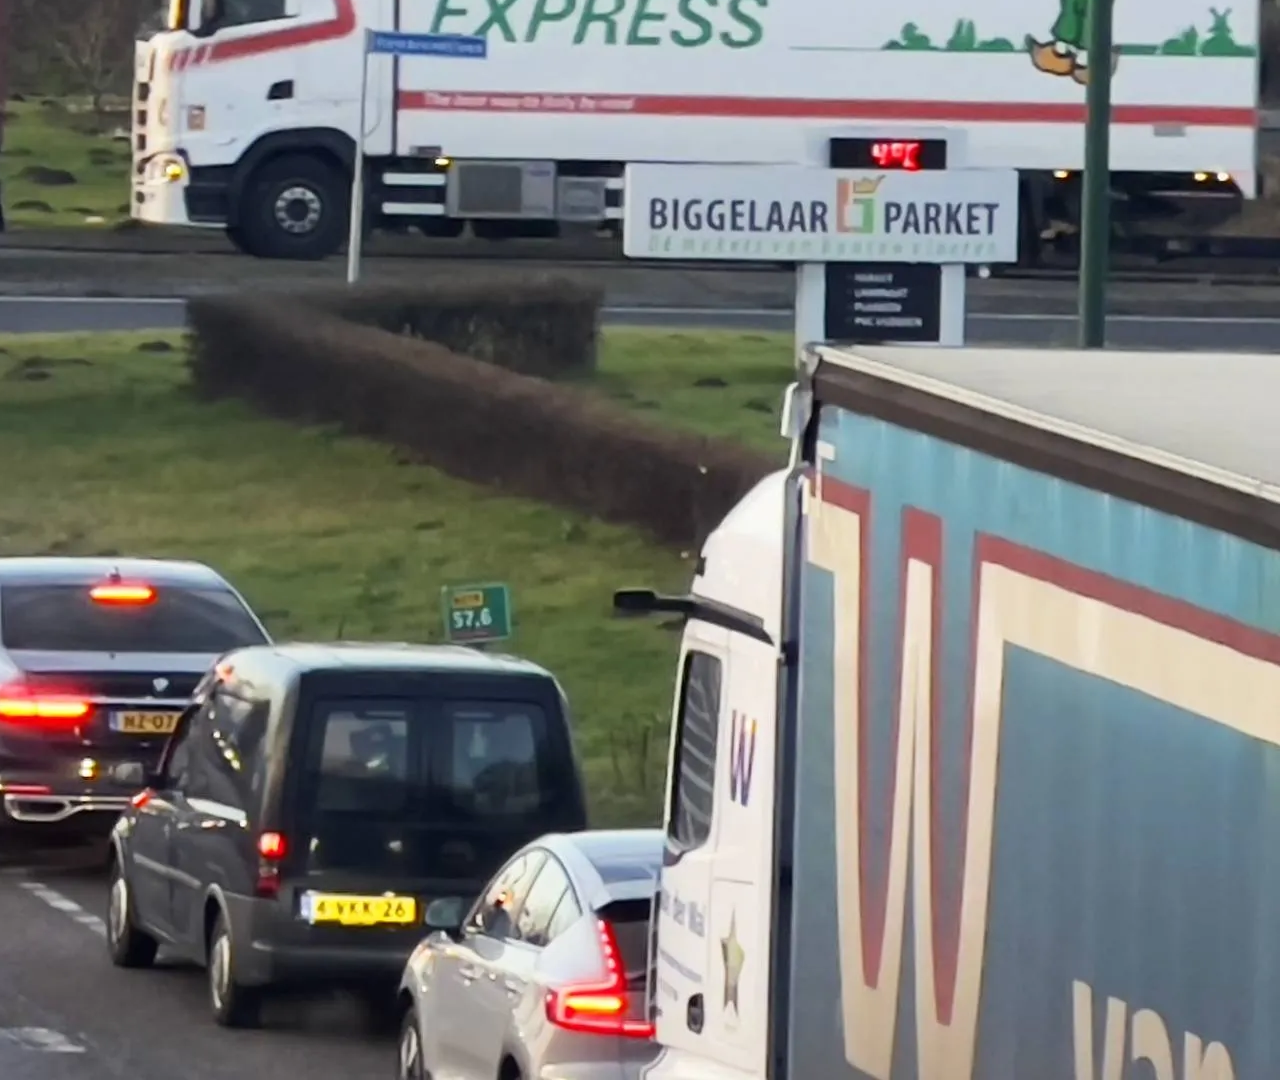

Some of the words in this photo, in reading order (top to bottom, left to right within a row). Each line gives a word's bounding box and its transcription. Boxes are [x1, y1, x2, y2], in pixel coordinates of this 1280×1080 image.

[648, 197, 829, 233] BIGGELAAR
[883, 201, 1000, 236] PARKET
[730, 709, 757, 807] W
